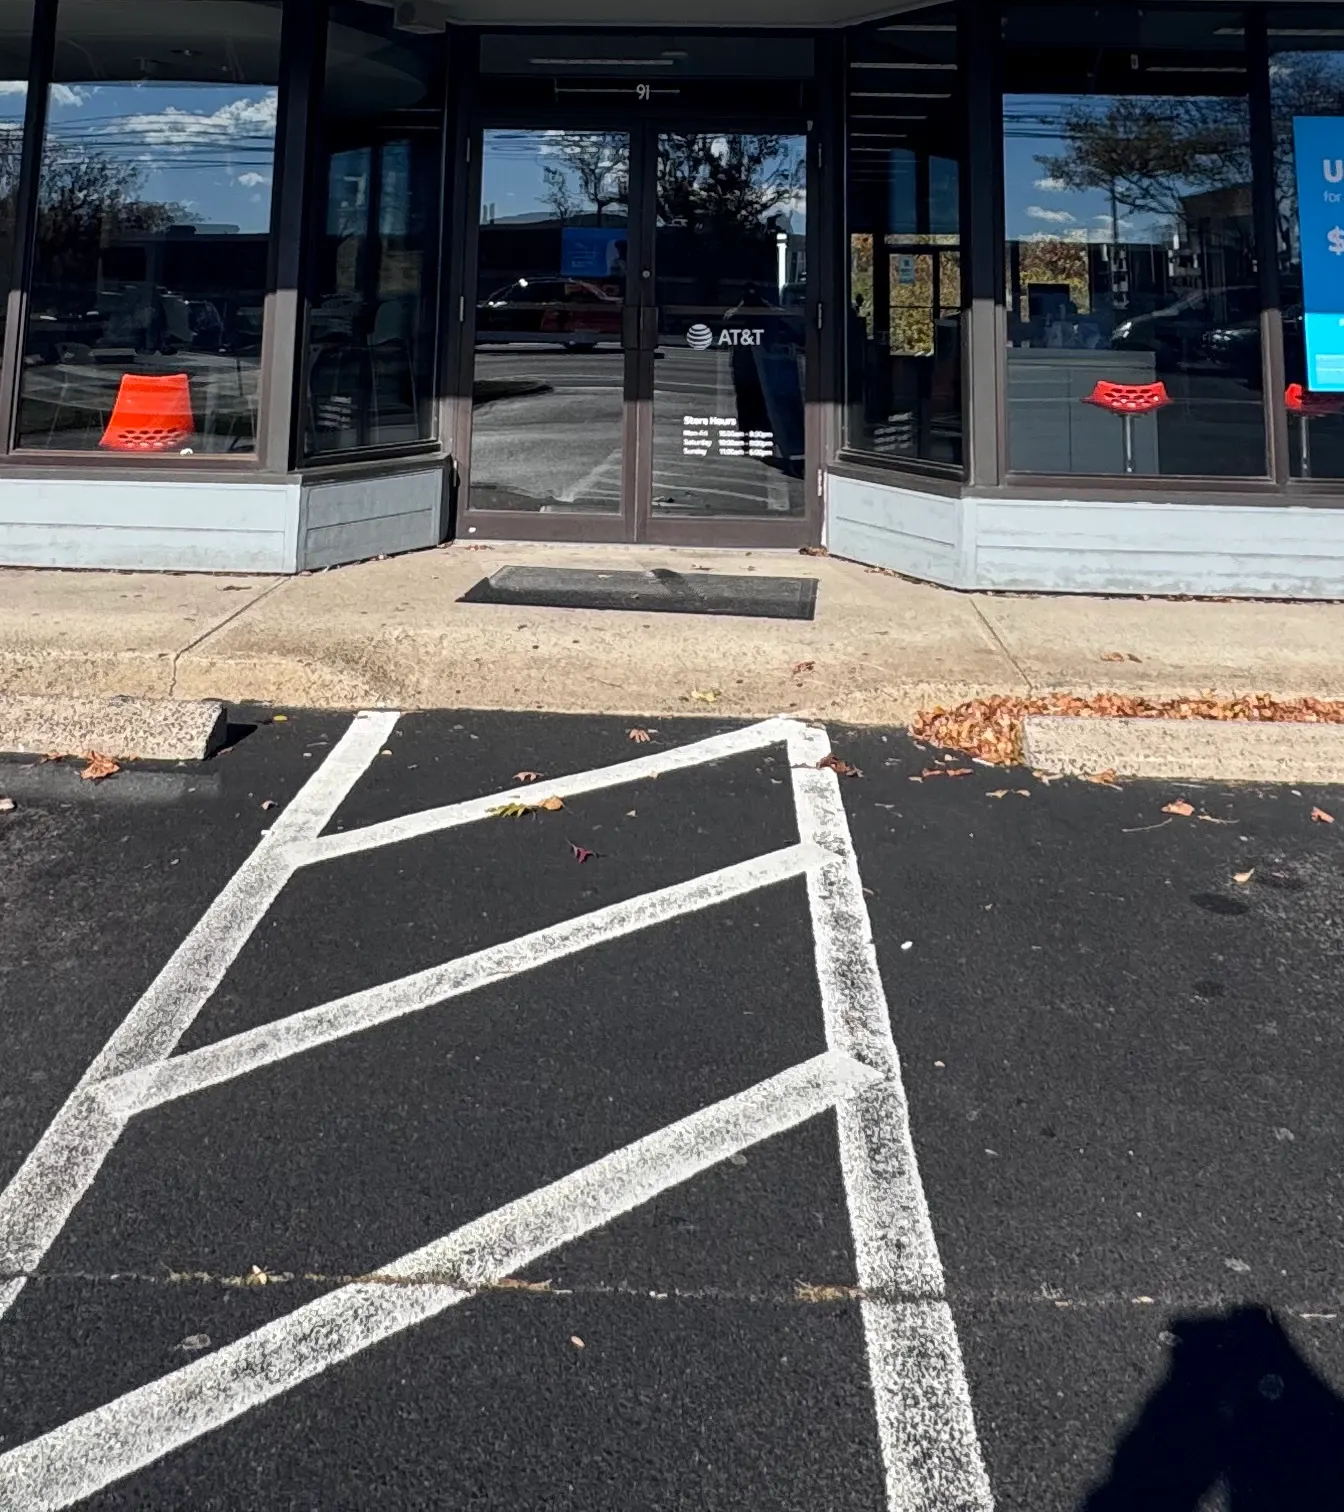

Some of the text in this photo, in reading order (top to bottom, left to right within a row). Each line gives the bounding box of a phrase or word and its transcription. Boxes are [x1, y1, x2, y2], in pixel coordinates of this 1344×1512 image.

[636, 83, 650, 100] 91
[1323, 190, 1341, 203] for
[717, 328, 765, 346] AT&T
